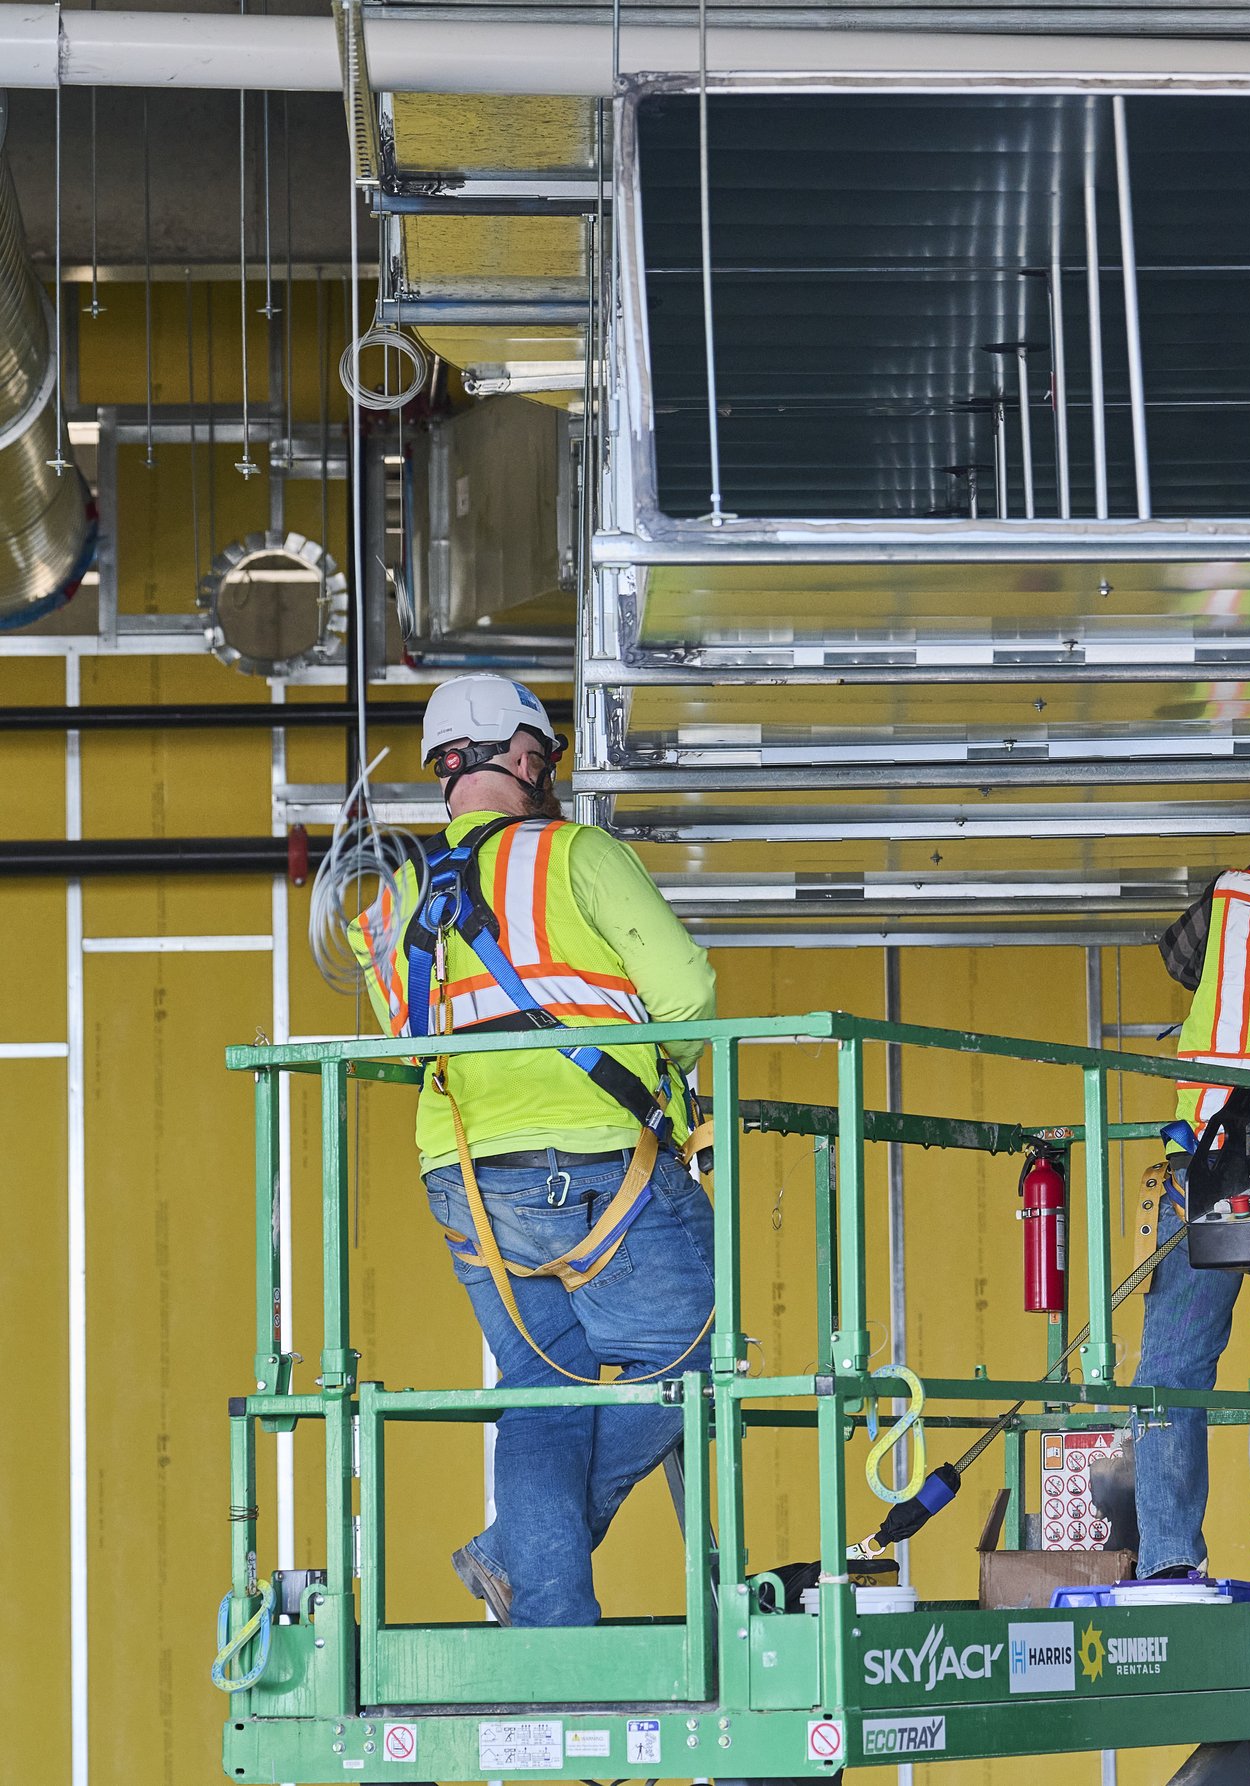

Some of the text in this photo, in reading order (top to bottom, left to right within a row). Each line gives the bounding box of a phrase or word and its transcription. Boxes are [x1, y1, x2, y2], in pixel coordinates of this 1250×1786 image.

[864, 1623, 1004, 1691] SKYJACK
[1029, 1646, 1072, 1666] HARRIS
[1107, 1637, 1168, 1664] SUNBELT
[1116, 1664, 1161, 1675] RENTALS
[865, 1717, 944, 1754] ECOTRAY
